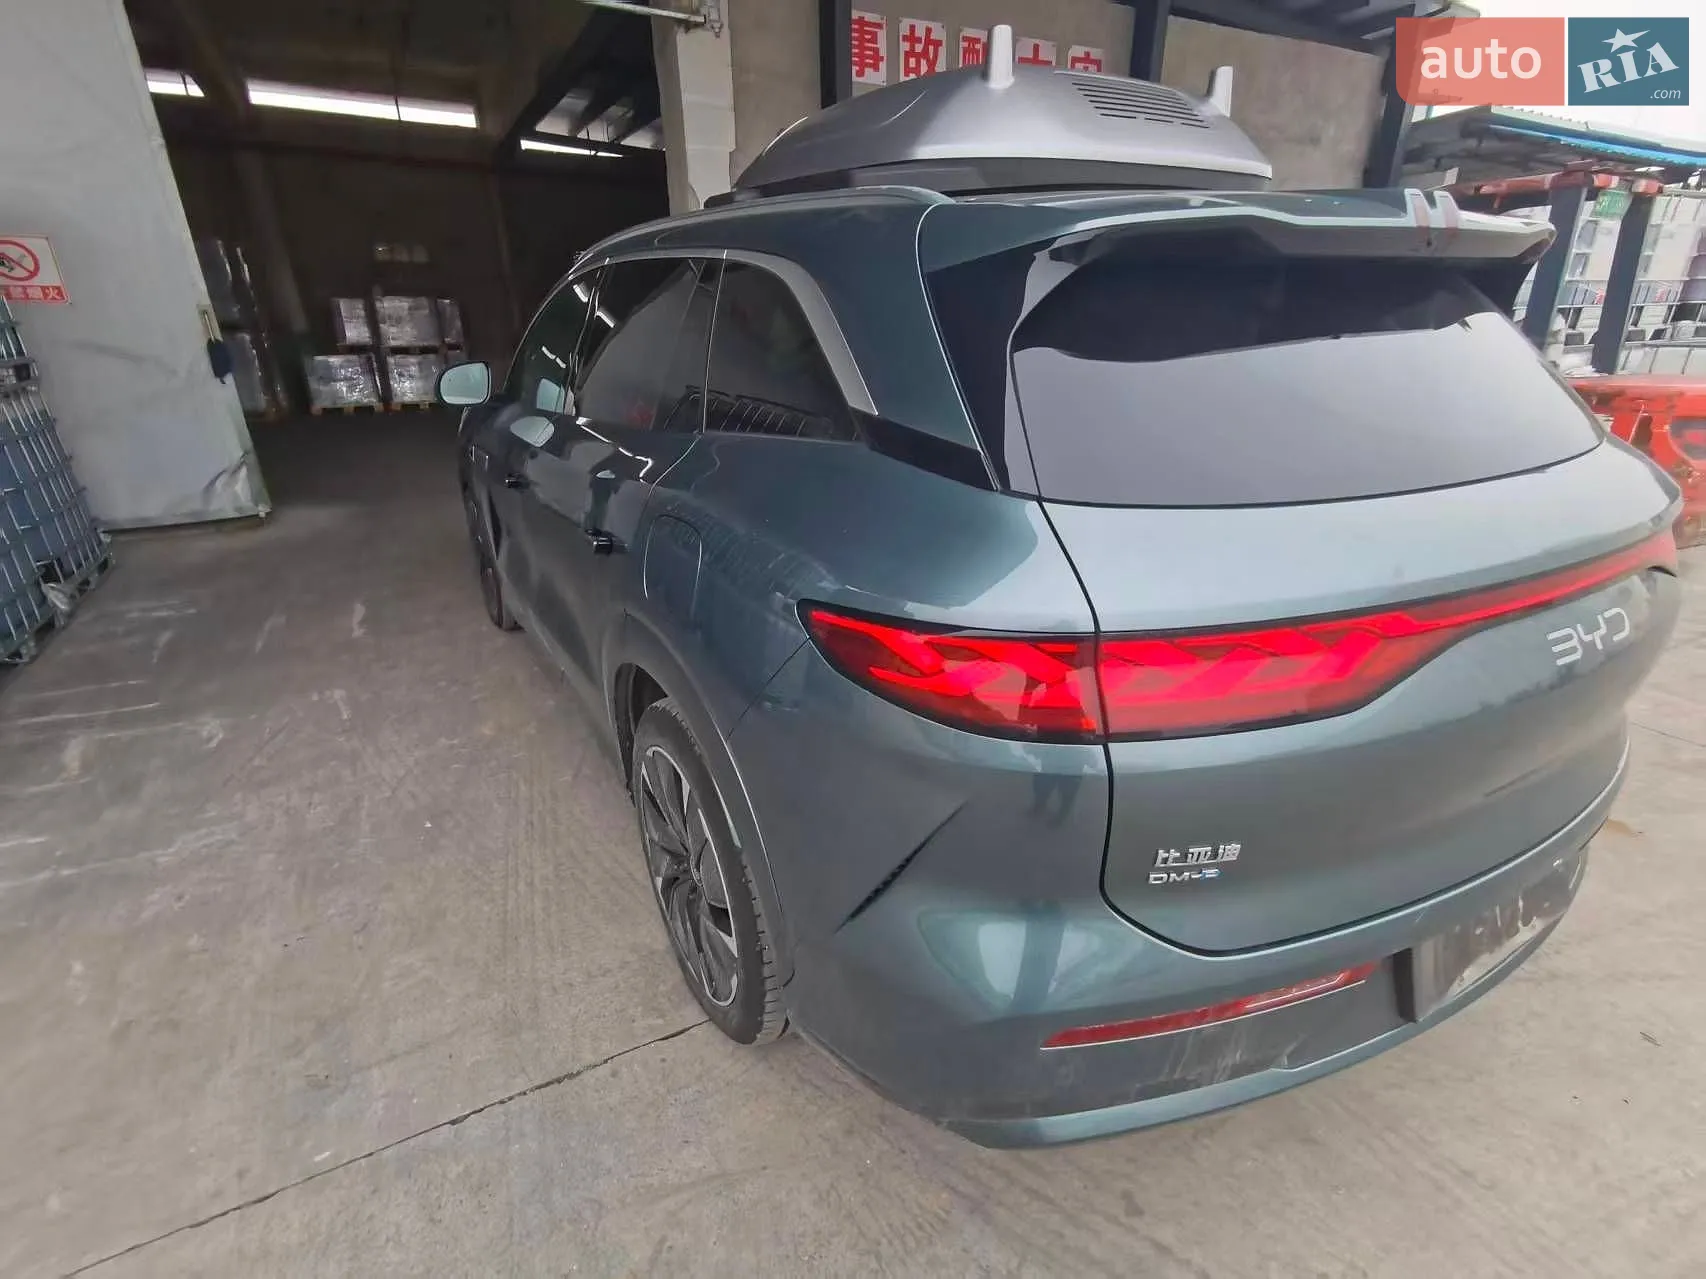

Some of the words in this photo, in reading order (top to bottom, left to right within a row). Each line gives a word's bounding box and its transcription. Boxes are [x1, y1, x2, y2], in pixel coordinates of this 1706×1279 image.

[1546, 607, 1630, 666] BYD
[1154, 843, 1241, 868] 比亚迪
